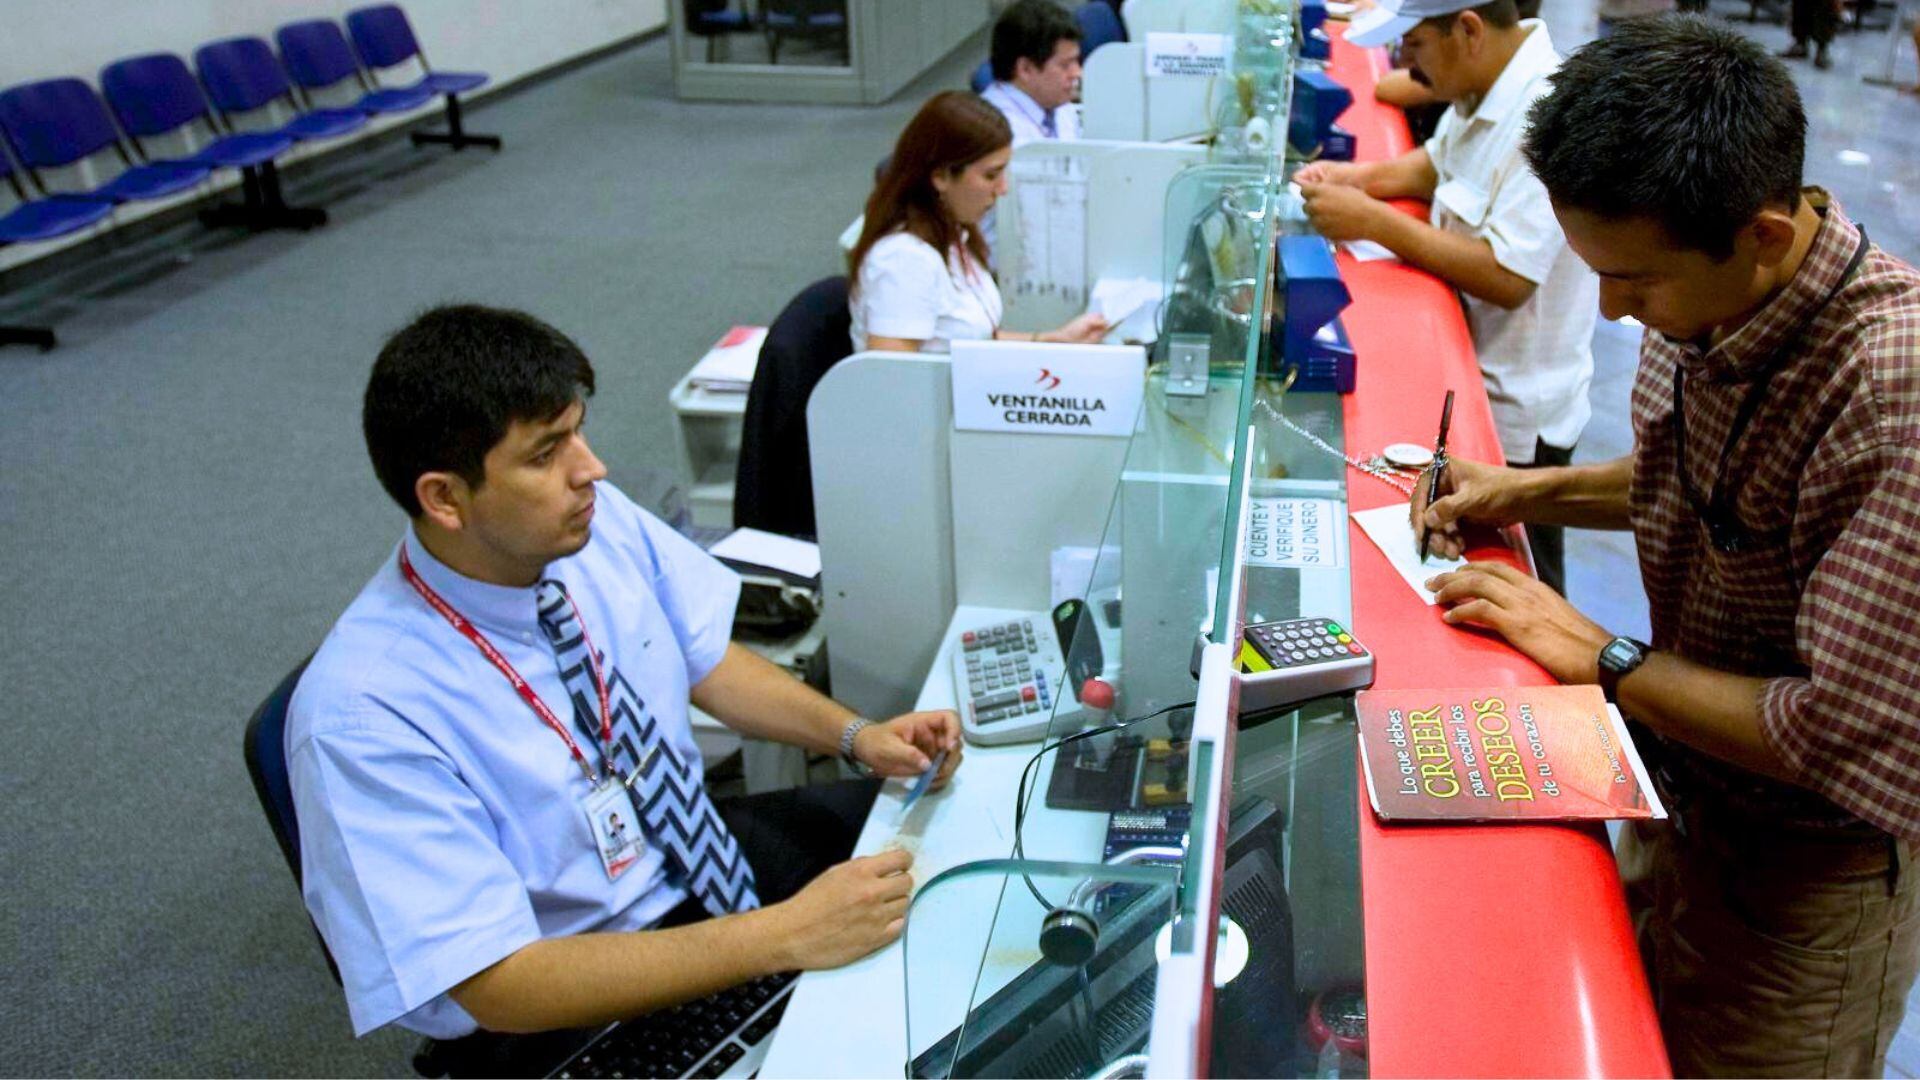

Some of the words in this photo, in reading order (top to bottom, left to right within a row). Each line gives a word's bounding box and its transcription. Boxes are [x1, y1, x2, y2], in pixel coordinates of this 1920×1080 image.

[987, 393, 1106, 411] VENTANILLA
[1004, 410, 1092, 427] CERRADA
[1250, 511, 1269, 558] CUENTE
[1276, 502, 1293, 561] VERIFIQUE
[1301, 500, 1319, 544] DINERO
[1302, 545, 1320, 563] SU
[1450, 704, 1465, 724] los
[1387, 708, 1407, 748] debes
[1519, 704, 1545, 759] corazón
[1408, 704, 1460, 798] CREER
[1453, 727, 1477, 767] recibir
[1472, 698, 1535, 802] DESEOS
[1397, 750, 1416, 775] que
[1537, 763, 1553, 776] tu
[1400, 777, 1418, 795] Lo
[1469, 770, 1491, 797] para
[1540, 780, 1559, 797] de
